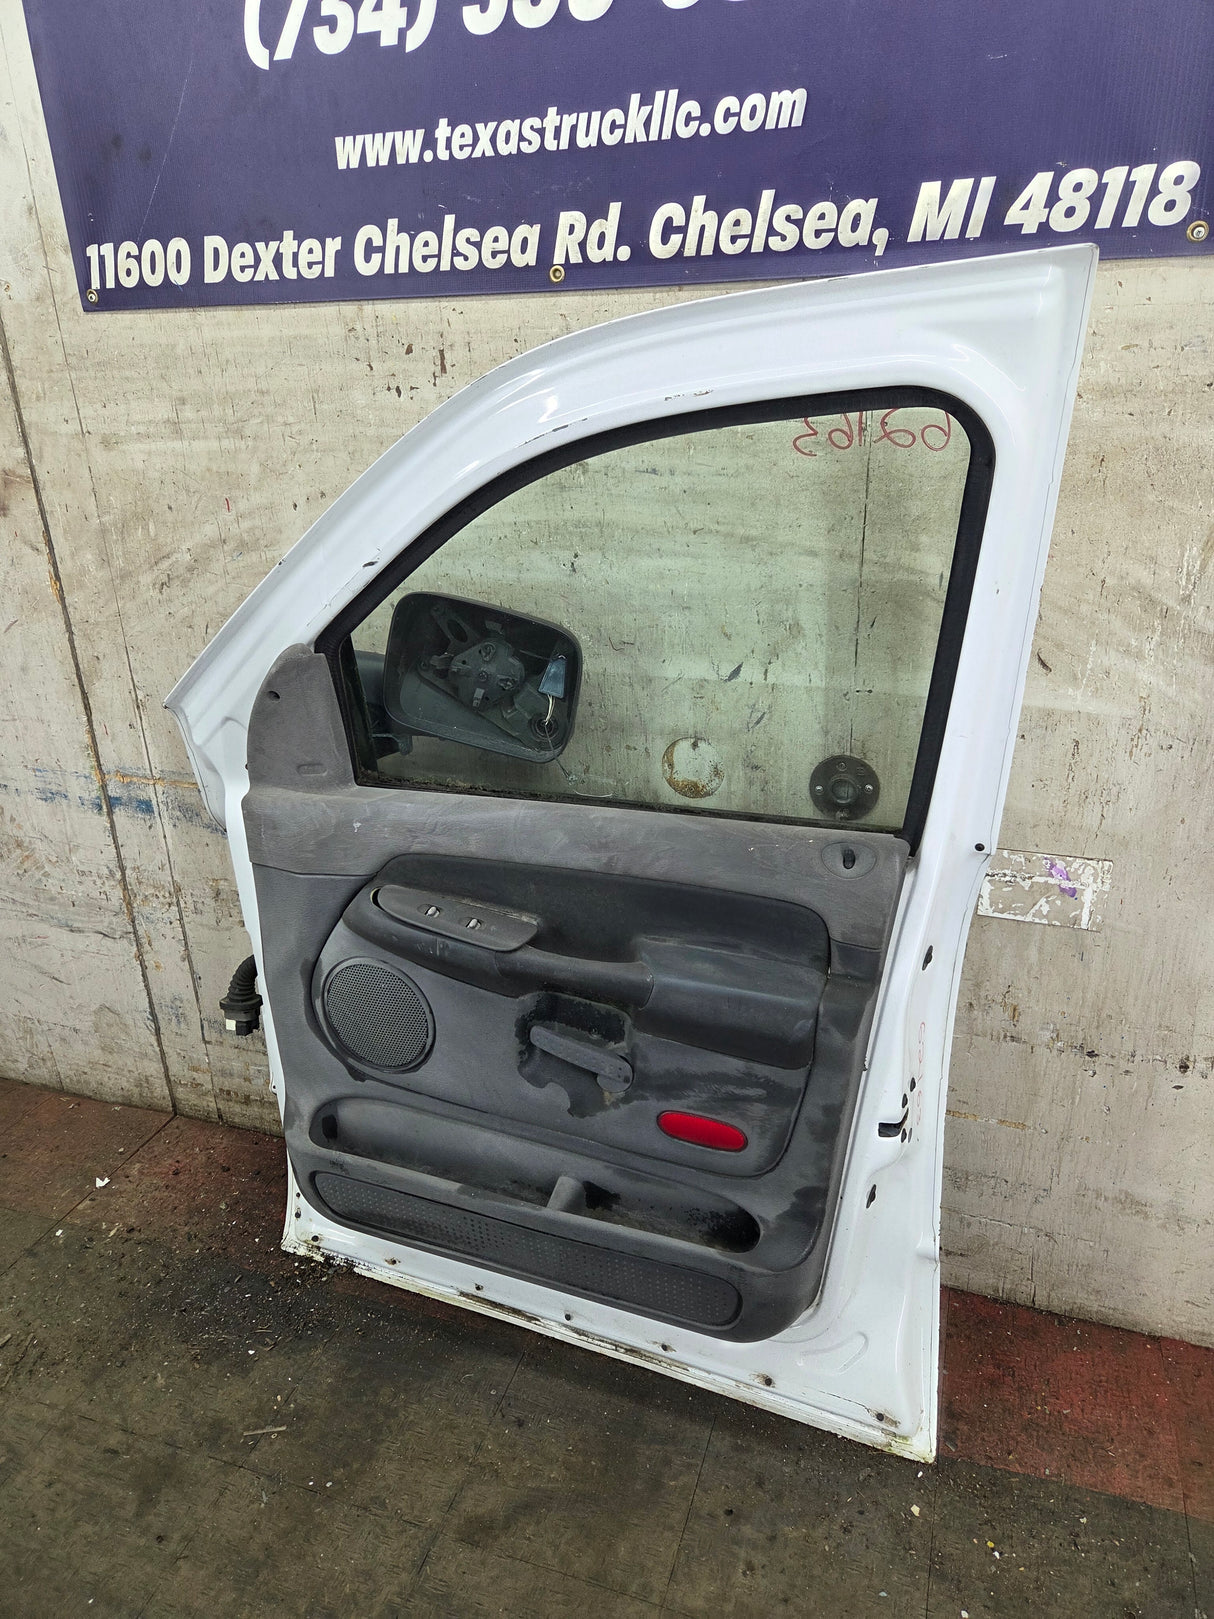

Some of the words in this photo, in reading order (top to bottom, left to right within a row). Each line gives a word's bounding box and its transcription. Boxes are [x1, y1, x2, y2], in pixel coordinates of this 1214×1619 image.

[335, 88, 807, 170] www.texastruckllc.com
[86, 237, 191, 290] 11600
[203, 230, 342, 284] Dexter
[353, 213, 541, 277] Chelsea
[552, 201, 631, 266] Rd.
[648, 189, 889, 257] Chelsea,
[906, 176, 997, 243] MI
[1003, 160, 1201, 234] 48118
